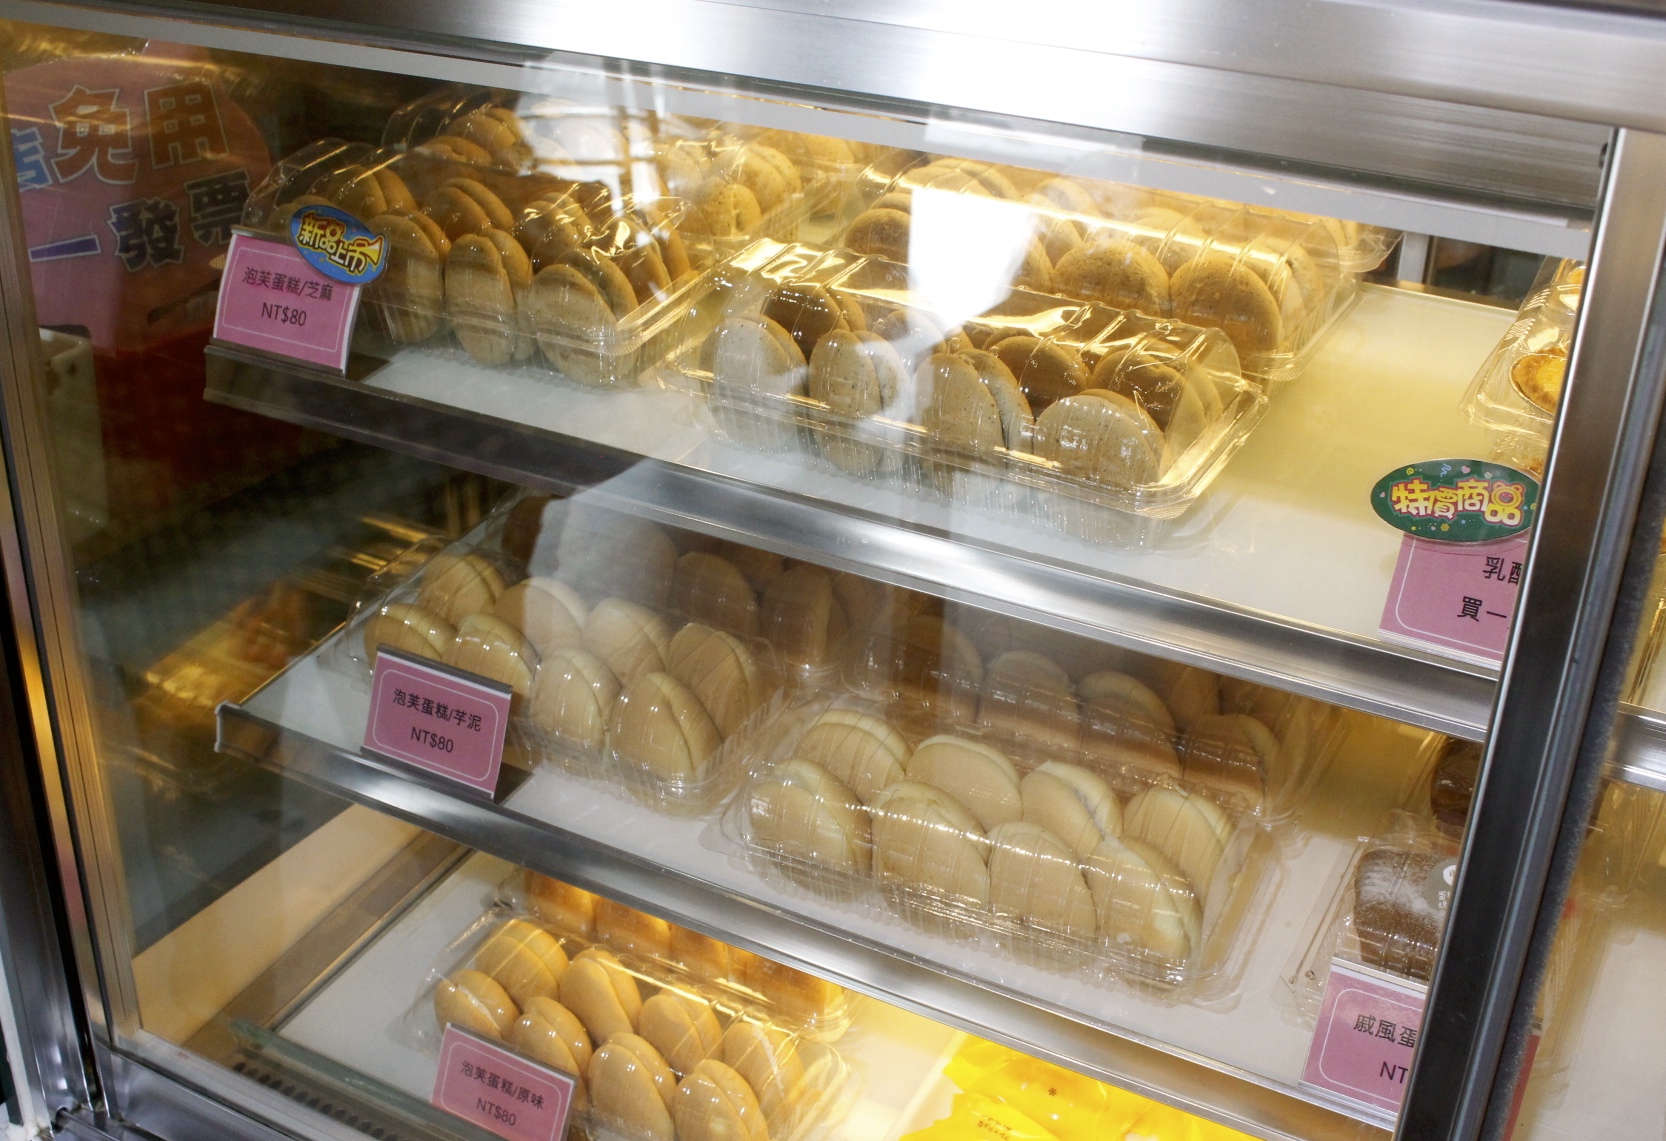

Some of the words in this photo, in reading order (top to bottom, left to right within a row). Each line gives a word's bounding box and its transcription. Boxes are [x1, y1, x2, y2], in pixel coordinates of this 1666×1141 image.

[297, 210, 385, 275] 新品上市
[242, 266, 334, 301] 泡芙蛋糕/芝麻
[261, 302, 307, 327] NT$80
[1390, 476, 1525, 526] 特價商品
[392, 688, 482, 732] 泡芙蛋糕/芋泥
[410, 726, 454, 753] NT$80
[460, 1060, 545, 1110] 泡芙蛋糕/原味
[476, 1097, 517, 1127] NT$80
